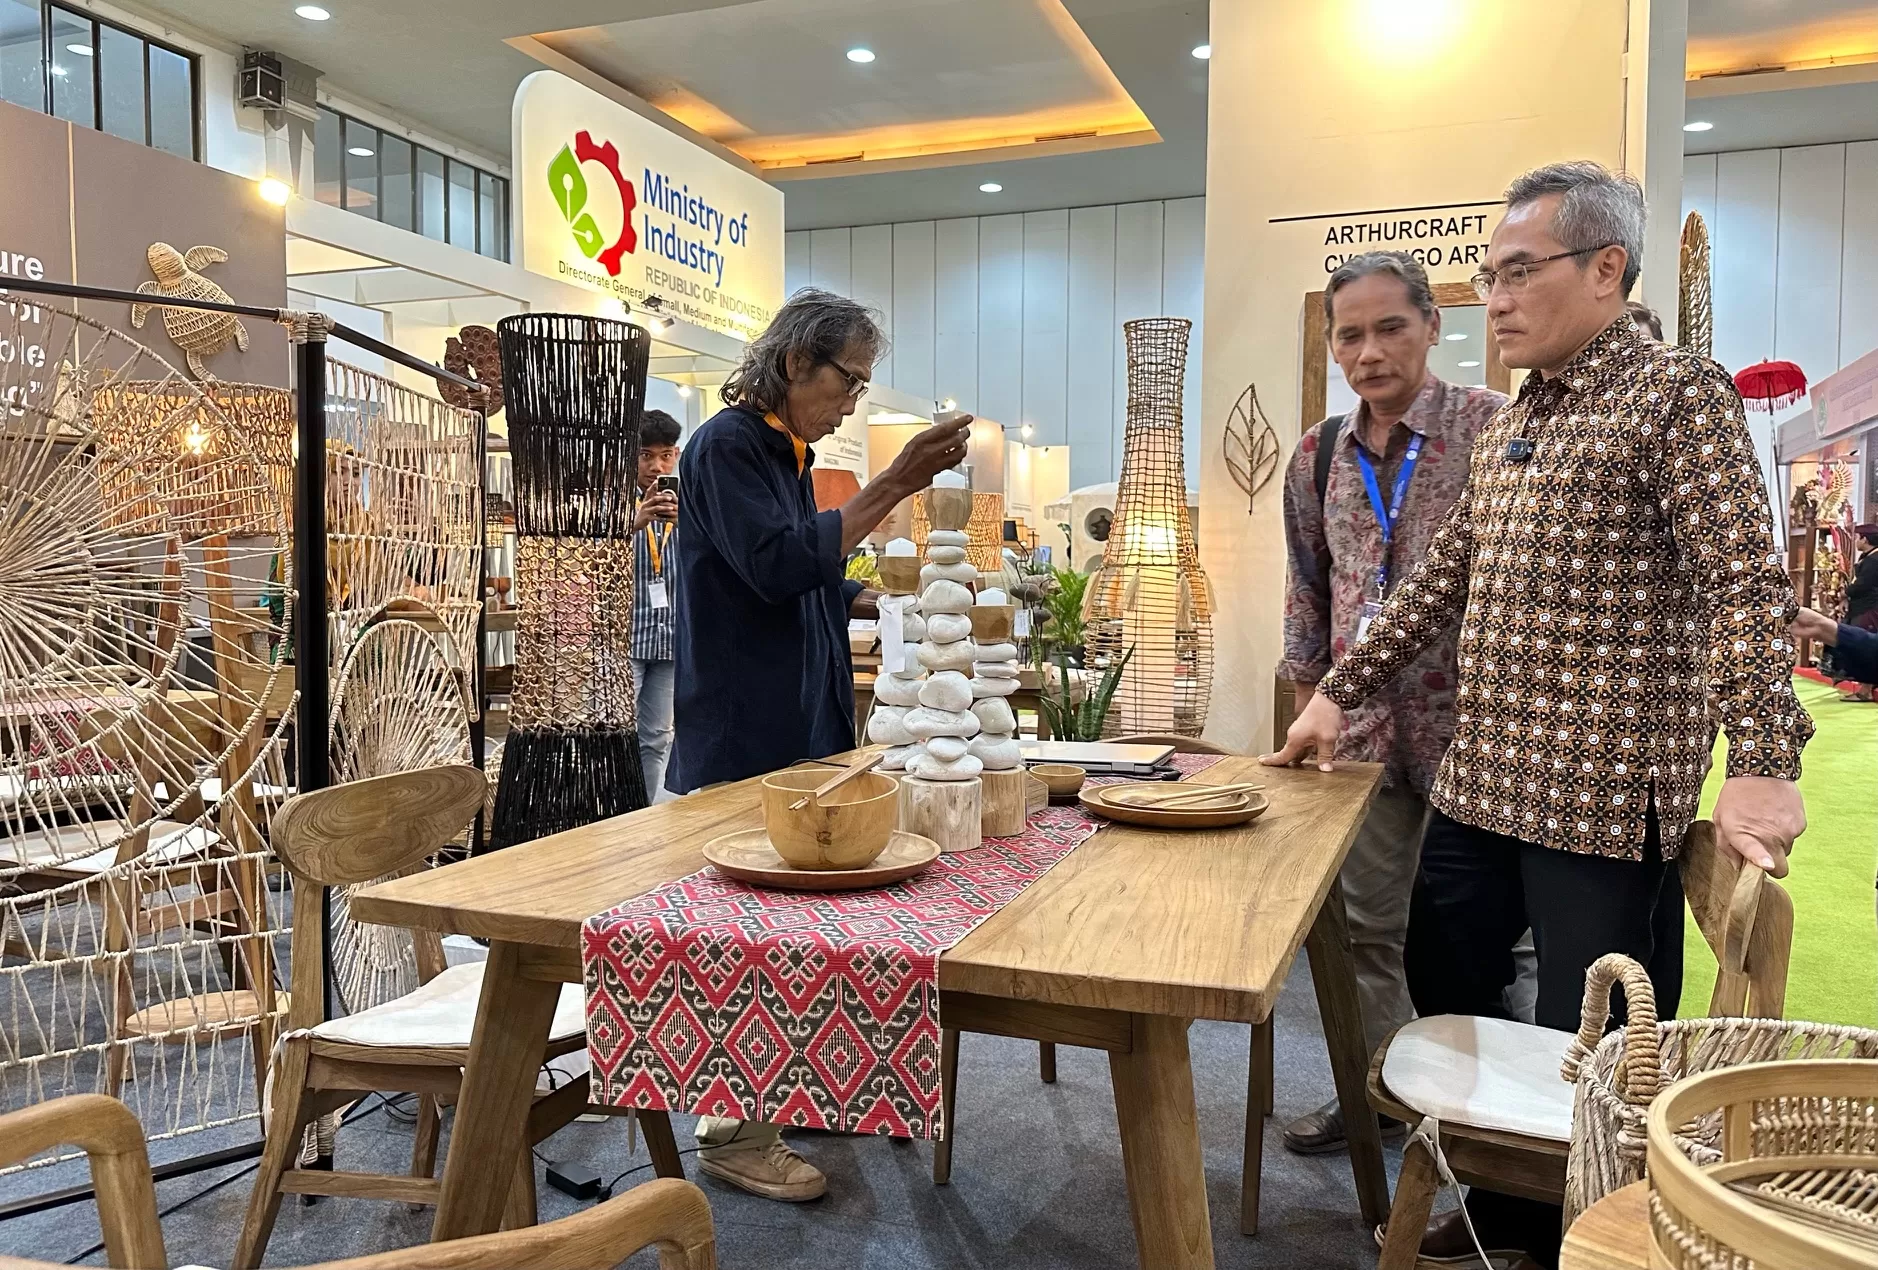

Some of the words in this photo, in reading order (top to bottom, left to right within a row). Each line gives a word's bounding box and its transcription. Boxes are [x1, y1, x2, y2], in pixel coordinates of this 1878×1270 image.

[643, 168, 724, 246] Ministry
[728, 212, 748, 248] of
[1324, 215, 1487, 245] ARTHURCRAFT
[643, 214, 725, 288] Industry
[558, 259, 610, 289] Directorate
[612, 279, 646, 300] General
[683, 302, 712, 323] Medium
[645, 265, 701, 300] REPUBLIC
[703, 287, 718, 305] OF
[719, 293, 771, 323] INDONESIA
